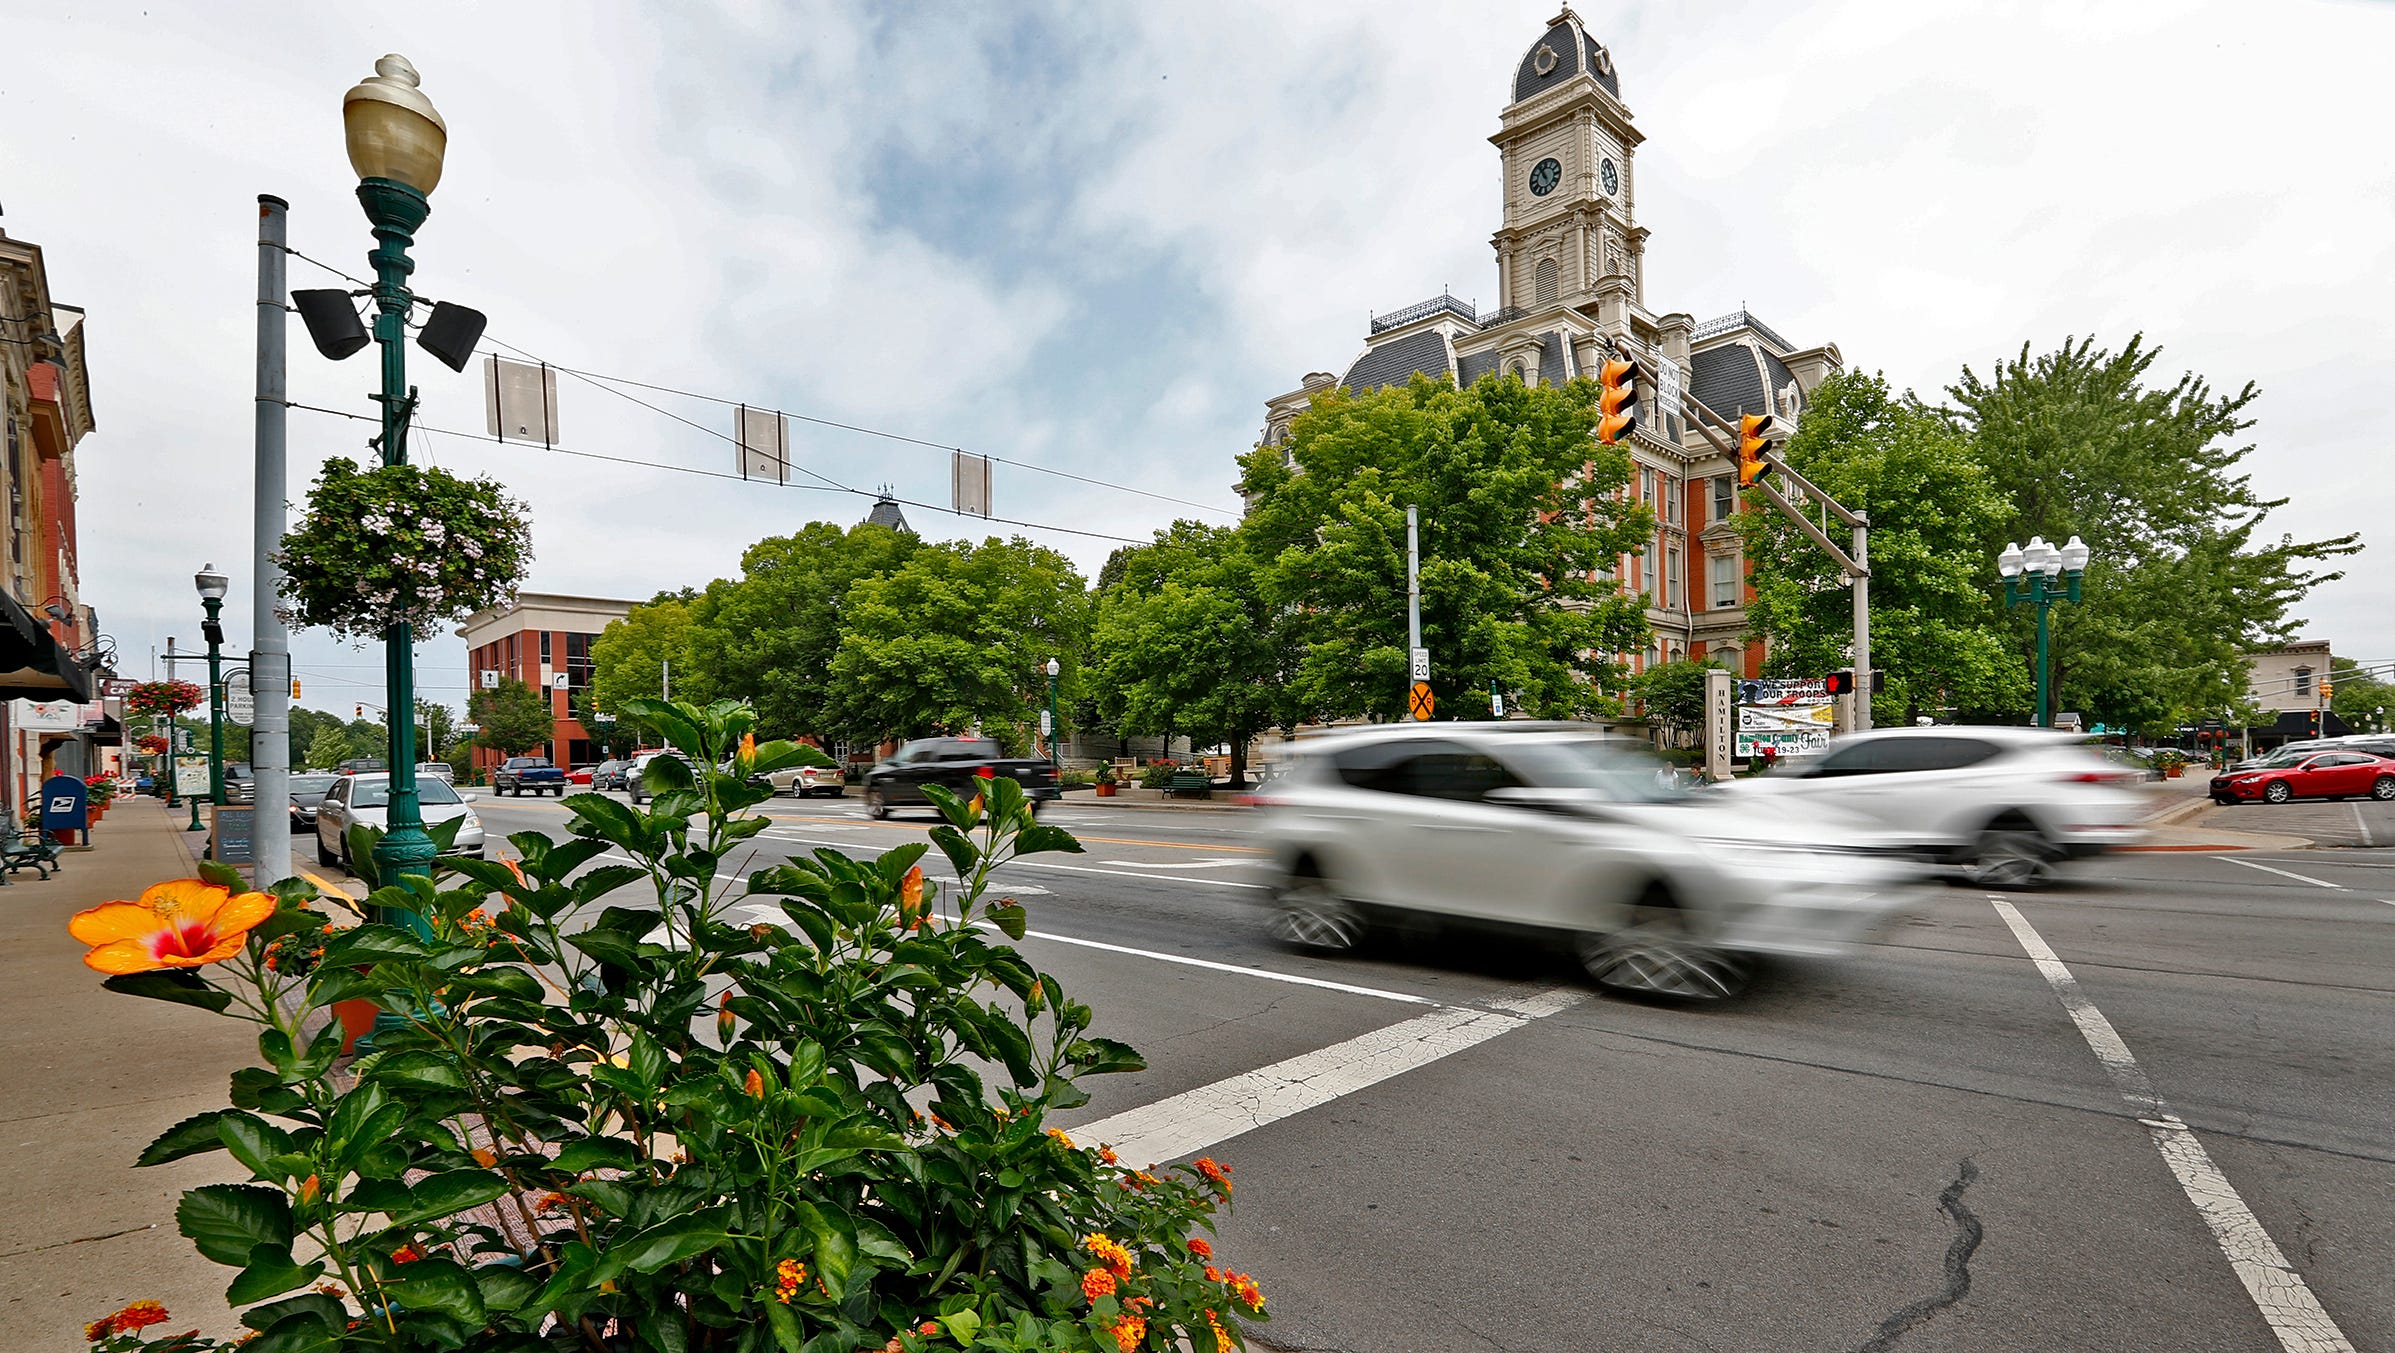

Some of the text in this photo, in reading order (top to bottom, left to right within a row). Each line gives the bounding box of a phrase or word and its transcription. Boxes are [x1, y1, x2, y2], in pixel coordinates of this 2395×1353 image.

[1660, 361, 1679, 382] DO NOT
[1660, 378, 1679, 398] BLOCK
[1415, 664, 1428, 676] 20
[1763, 680, 1826, 689] WE SUPPORT
[1763, 690, 1826, 699] OUR TROOPS
[1412, 697, 1416, 705] R
[1427, 698, 1432, 706] R
[1718, 689, 1726, 761] HAMILTON
[1739, 731, 1828, 750] Hamilton County Fair
[1777, 746, 1799, 754] 19-23
